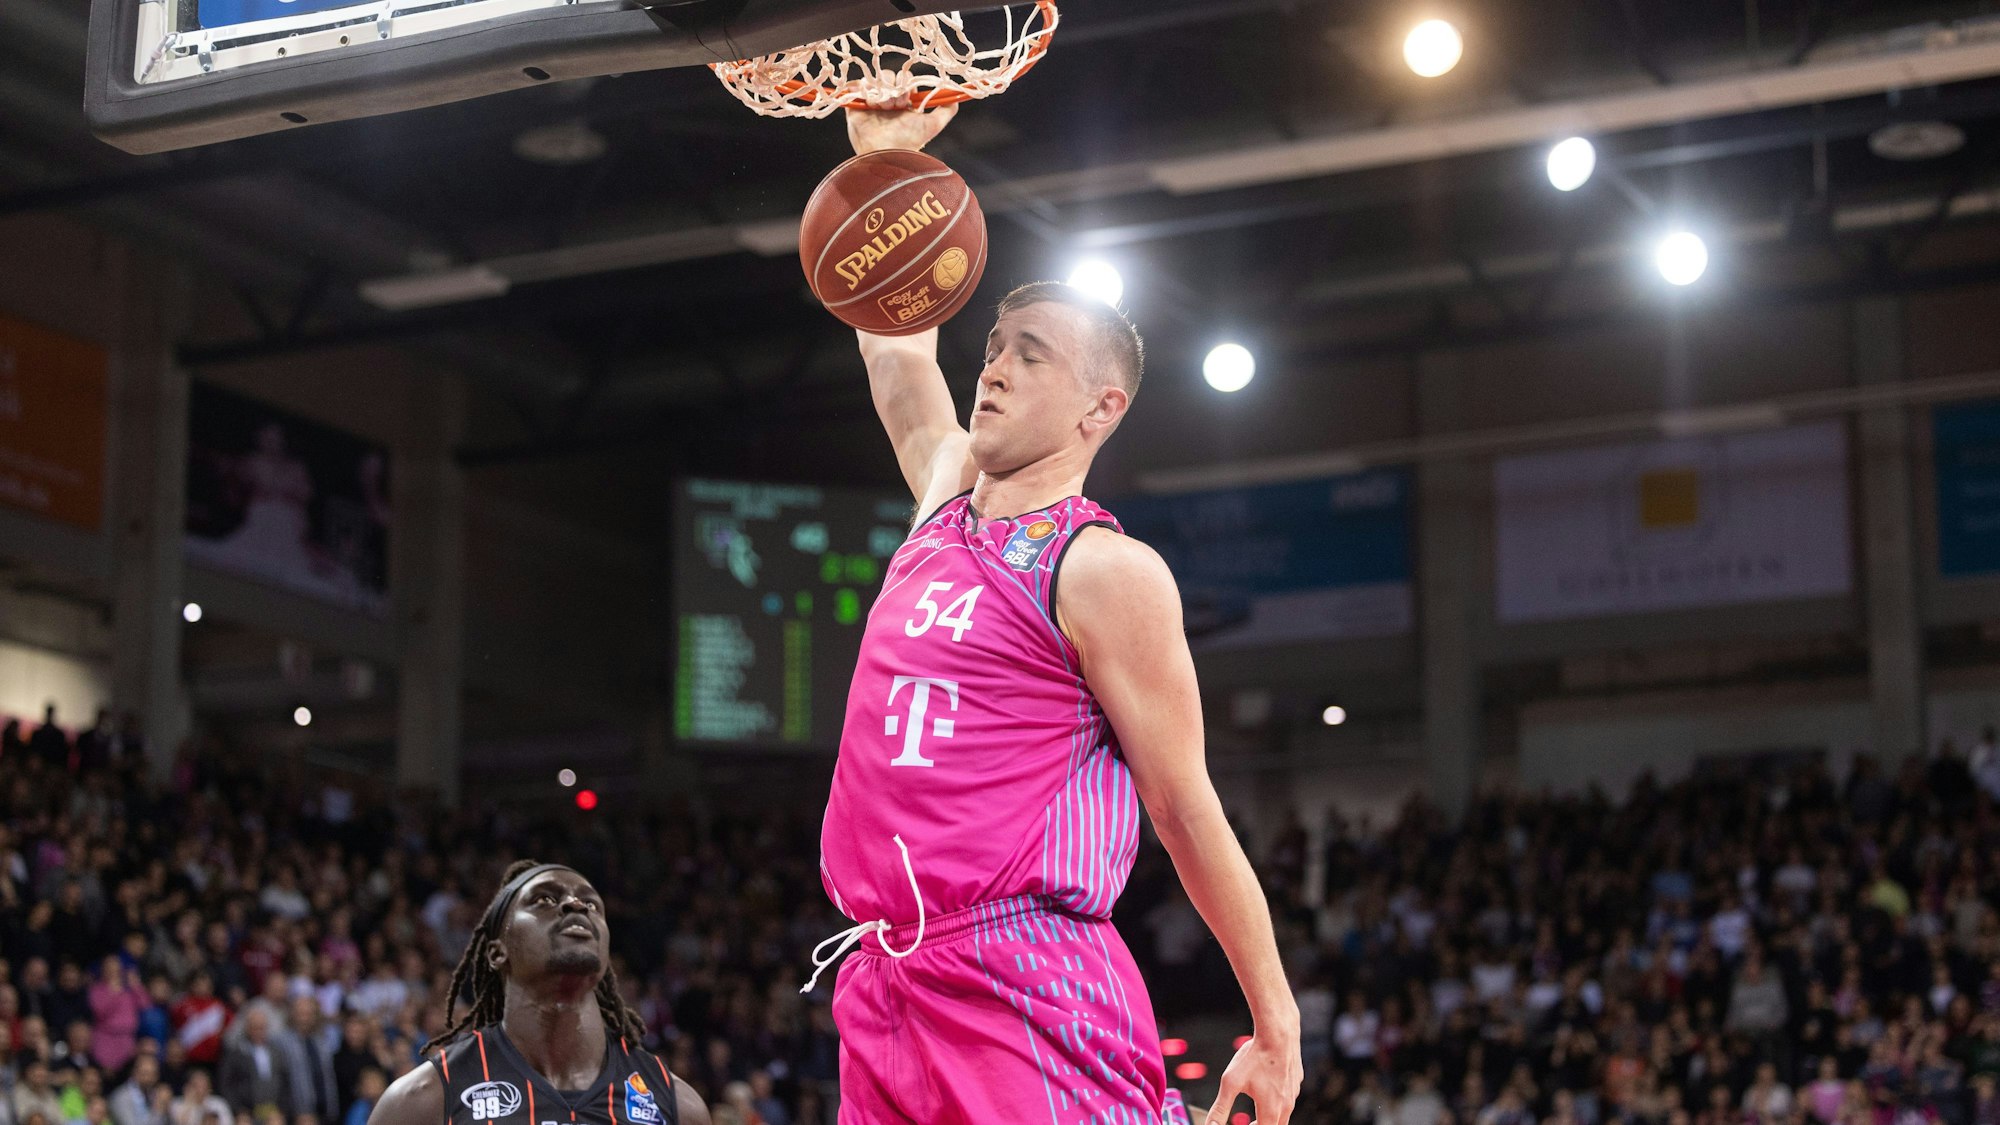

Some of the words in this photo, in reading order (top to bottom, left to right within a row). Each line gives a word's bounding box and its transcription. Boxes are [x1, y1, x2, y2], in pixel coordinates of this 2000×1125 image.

[835, 190, 947, 291] SPALDING
[897, 294, 938, 321] BBL
[1003, 551, 1030, 566] BBL
[904, 581, 984, 643] 54
[885, 676, 959, 767] T
[472, 1089, 500, 1099] CHEMNITZ
[472, 1097, 500, 1120] 99
[631, 1106, 660, 1122] BBL
